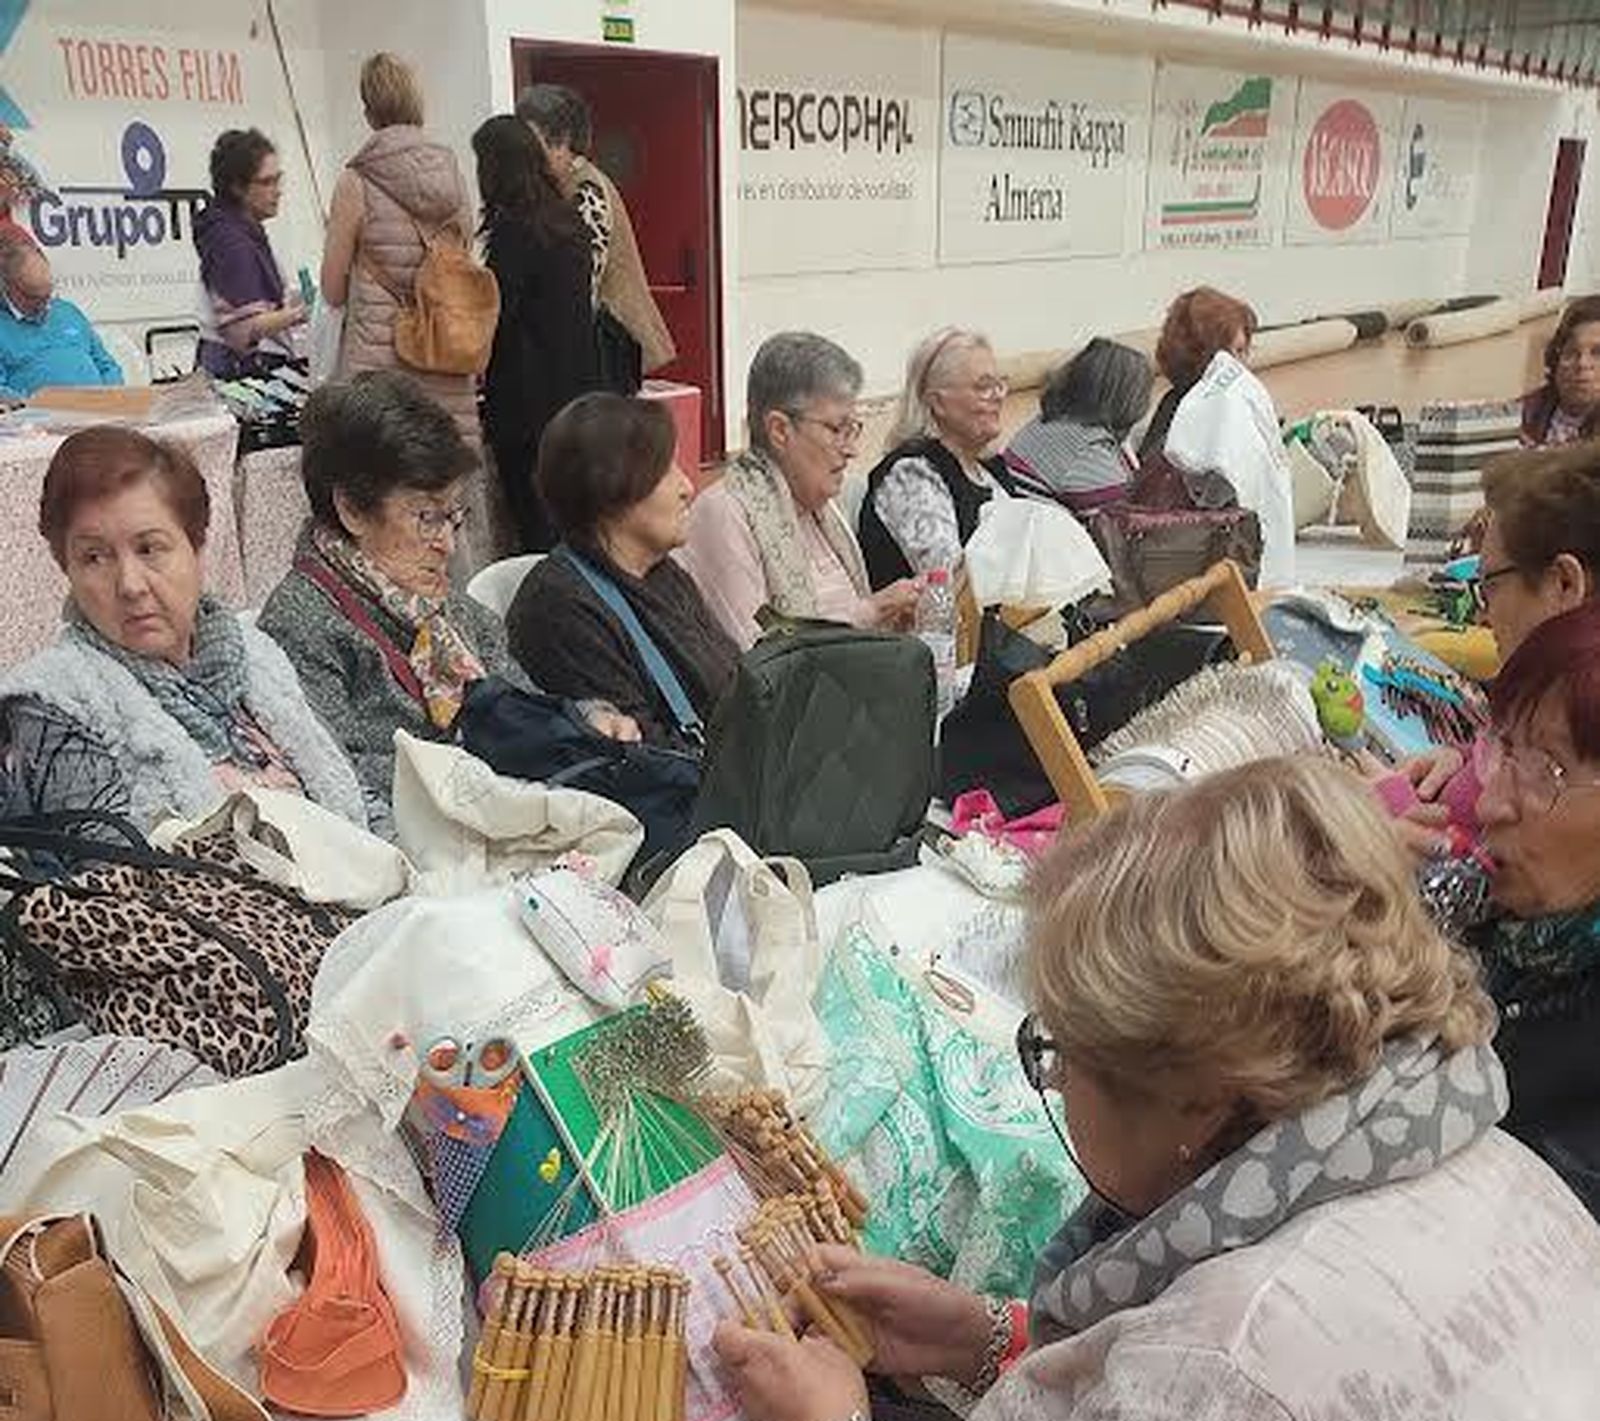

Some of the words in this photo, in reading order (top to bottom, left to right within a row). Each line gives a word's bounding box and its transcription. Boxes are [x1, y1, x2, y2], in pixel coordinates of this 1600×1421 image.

[58, 38, 170, 100] TORRES
[178, 48, 243, 104] FILM
[989, 96, 1063, 150] Smurfit
[1070, 103, 1125, 168] Kappa
[31, 188, 166, 259] Grupo
